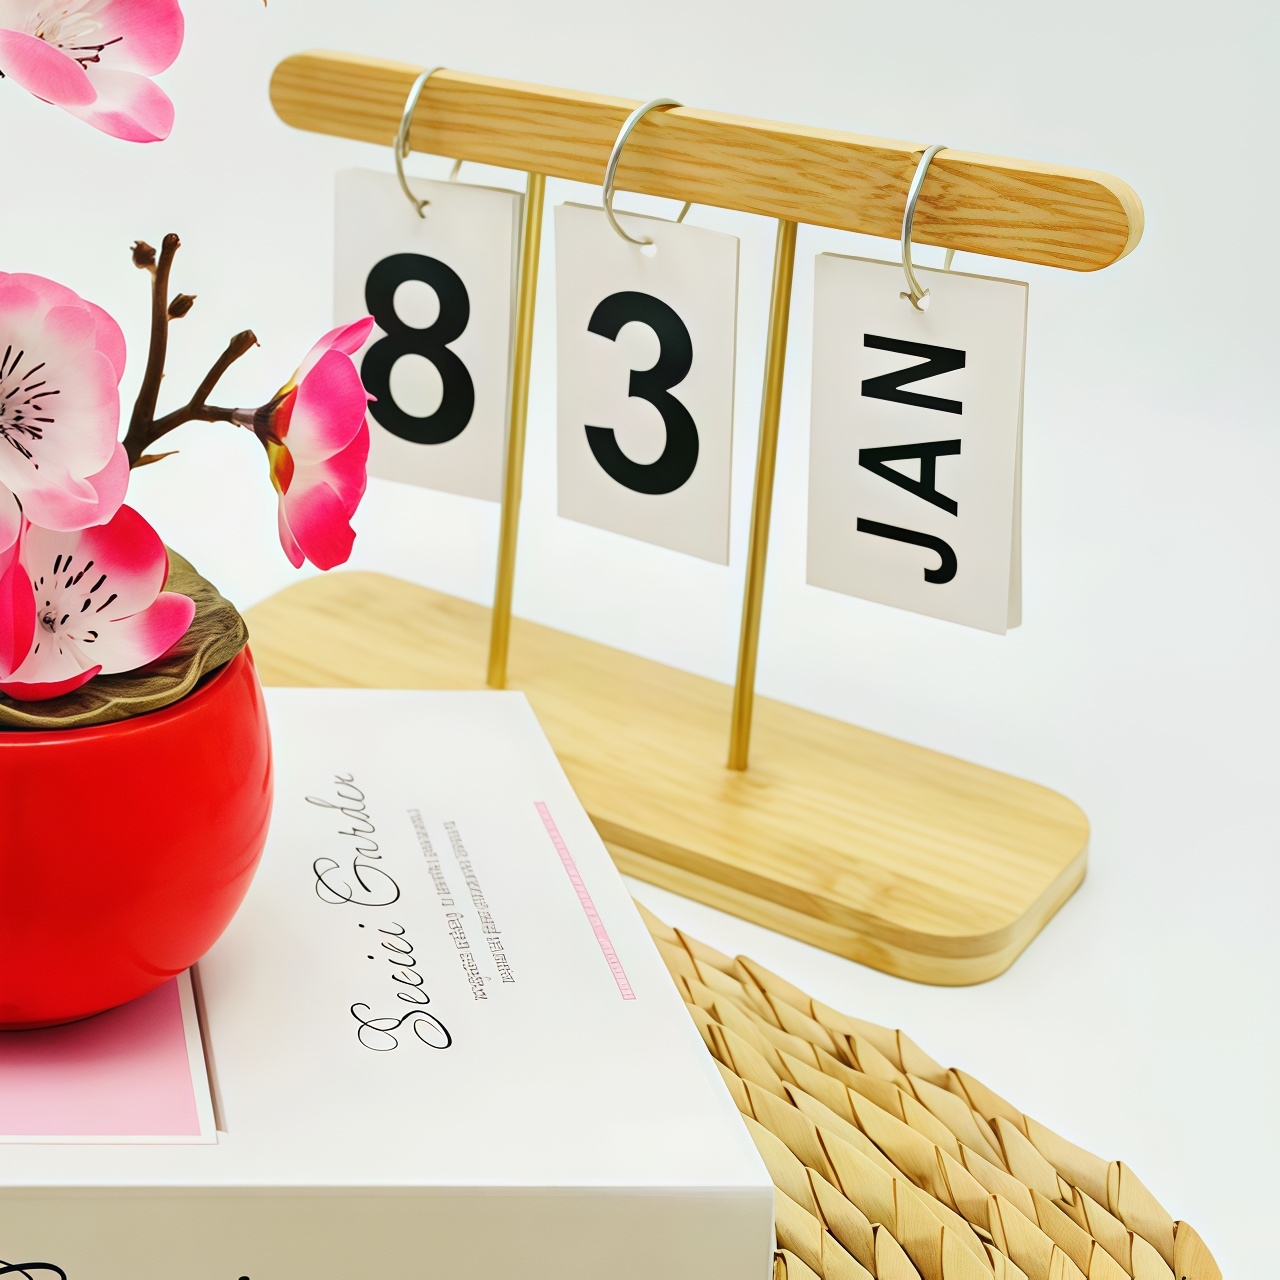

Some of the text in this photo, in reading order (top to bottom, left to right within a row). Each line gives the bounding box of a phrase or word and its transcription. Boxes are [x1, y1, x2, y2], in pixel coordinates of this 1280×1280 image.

[361, 253, 475, 444] 8
[585, 291, 699, 494] 3
[856, 333, 966, 585] JAN
